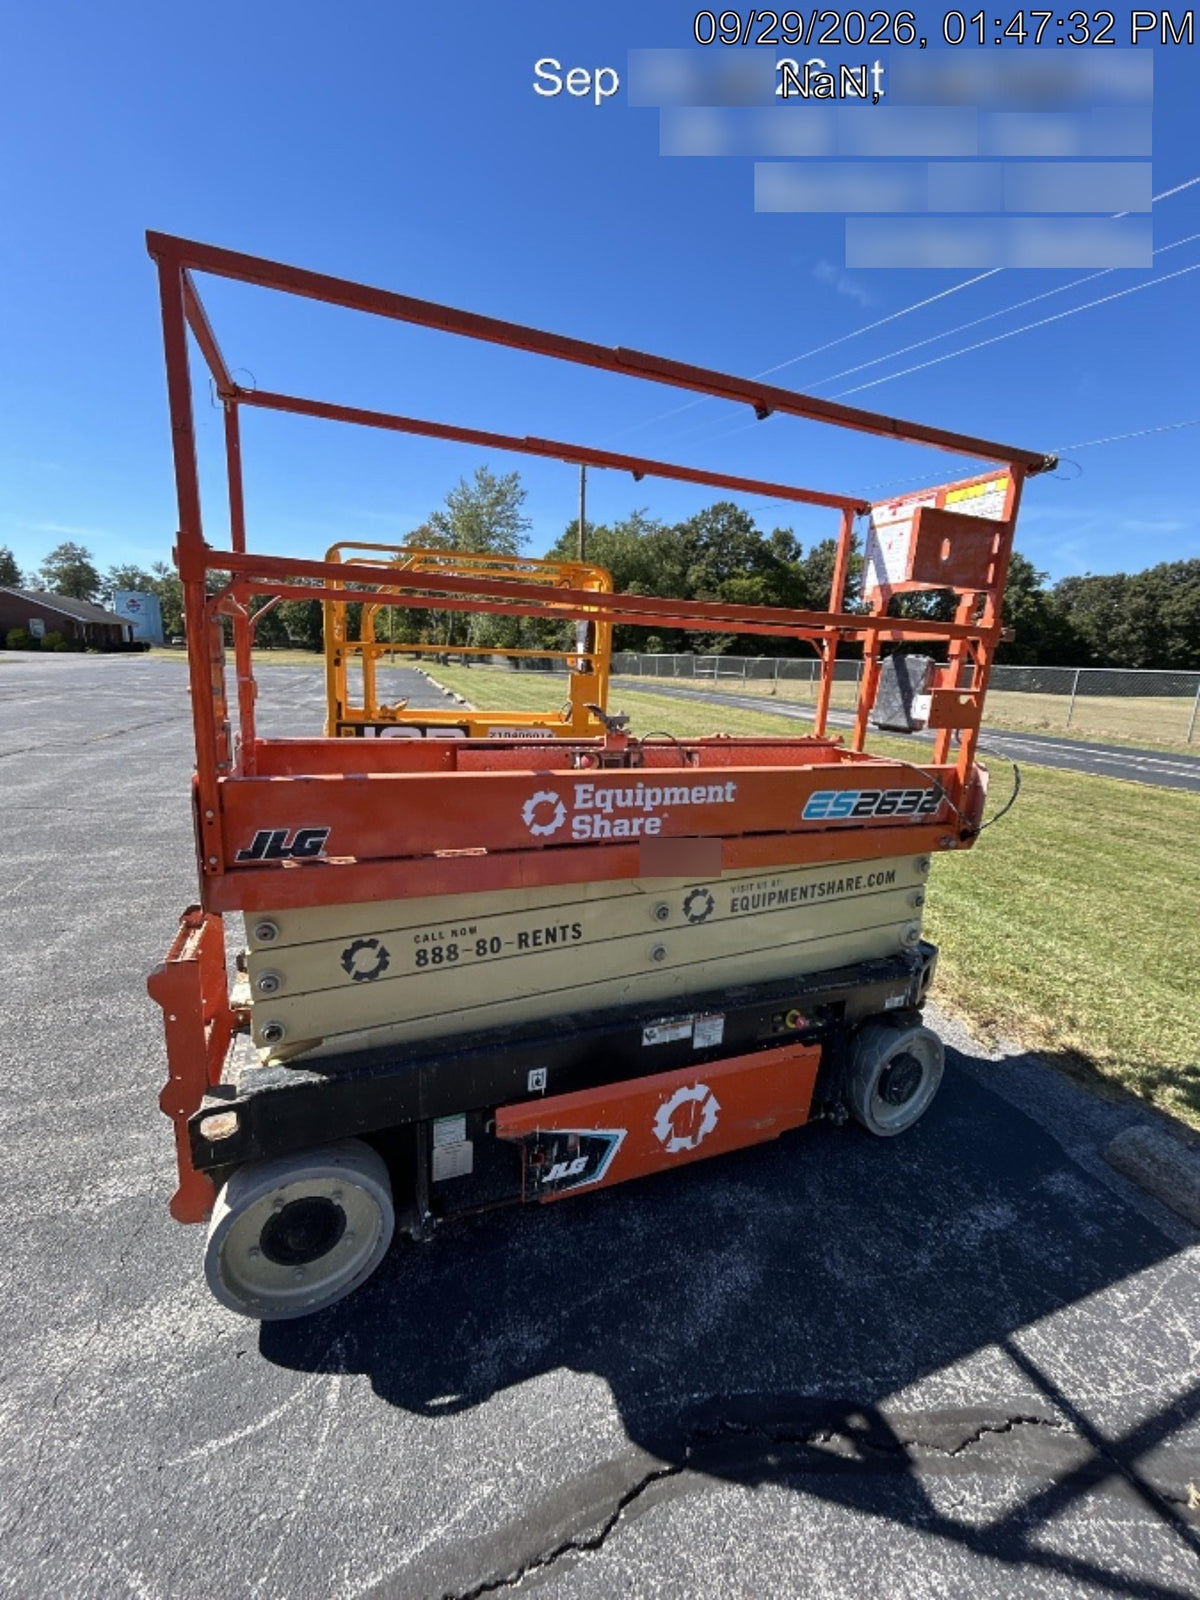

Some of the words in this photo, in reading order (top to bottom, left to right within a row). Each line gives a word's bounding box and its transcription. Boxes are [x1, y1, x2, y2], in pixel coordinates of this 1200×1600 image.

[573, 782, 737, 813] Equipment
[802, 788, 944, 820] ES2632
[571, 814, 662, 839] Share
[234, 827, 331, 862] JLG
[730, 869, 897, 913] EQUIPMENTSHARE.COM
[413, 932, 445, 944] CALL
[451, 926, 478, 937] NOW
[415, 922, 583, 967] 888-80-RENTS
[541, 1155, 589, 1183] JLG
